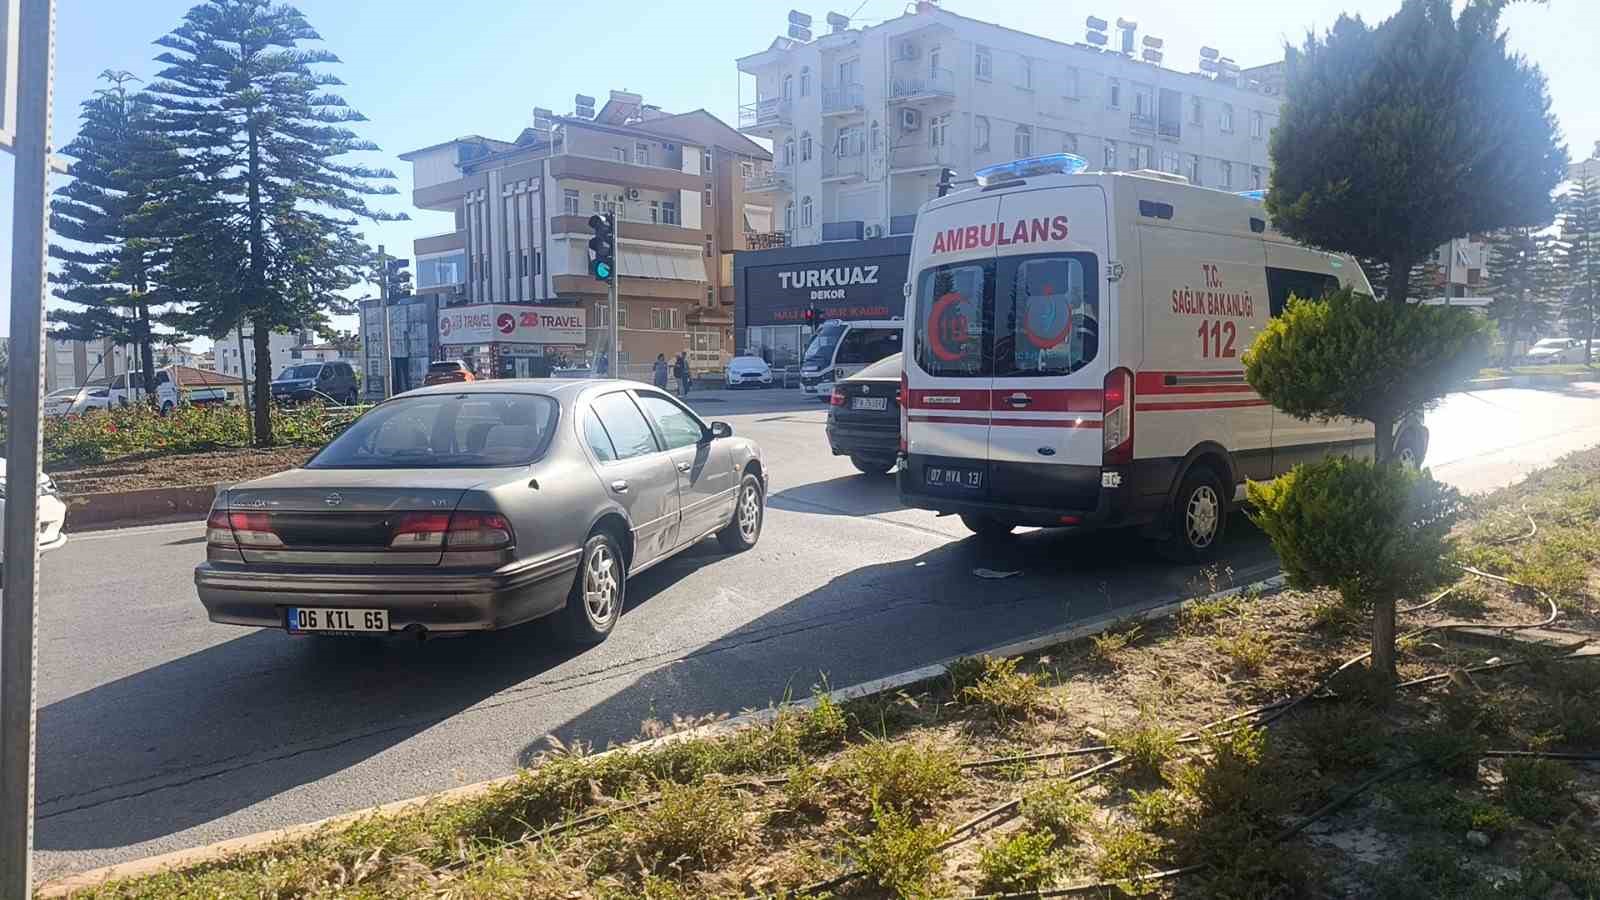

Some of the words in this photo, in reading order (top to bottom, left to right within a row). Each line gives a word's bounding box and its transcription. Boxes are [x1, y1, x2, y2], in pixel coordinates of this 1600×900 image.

[932, 215, 1069, 253] AMBULANS
[778, 265, 879, 288] TURKUAZ
[1203, 264, 1223, 288] T.C.
[810, 289, 846, 300] DEKOR
[1172, 286, 1206, 316] SAĞLIK
[1208, 290, 1254, 318] BAKANLIĞI
[464, 312, 492, 328] TRAVEL
[540, 315, 583, 328] TRAVEL
[1198, 319, 1236, 358] 112
[299, 610, 317, 628] 06
[326, 611, 354, 629] KTL
[364, 611, 383, 629] 65
